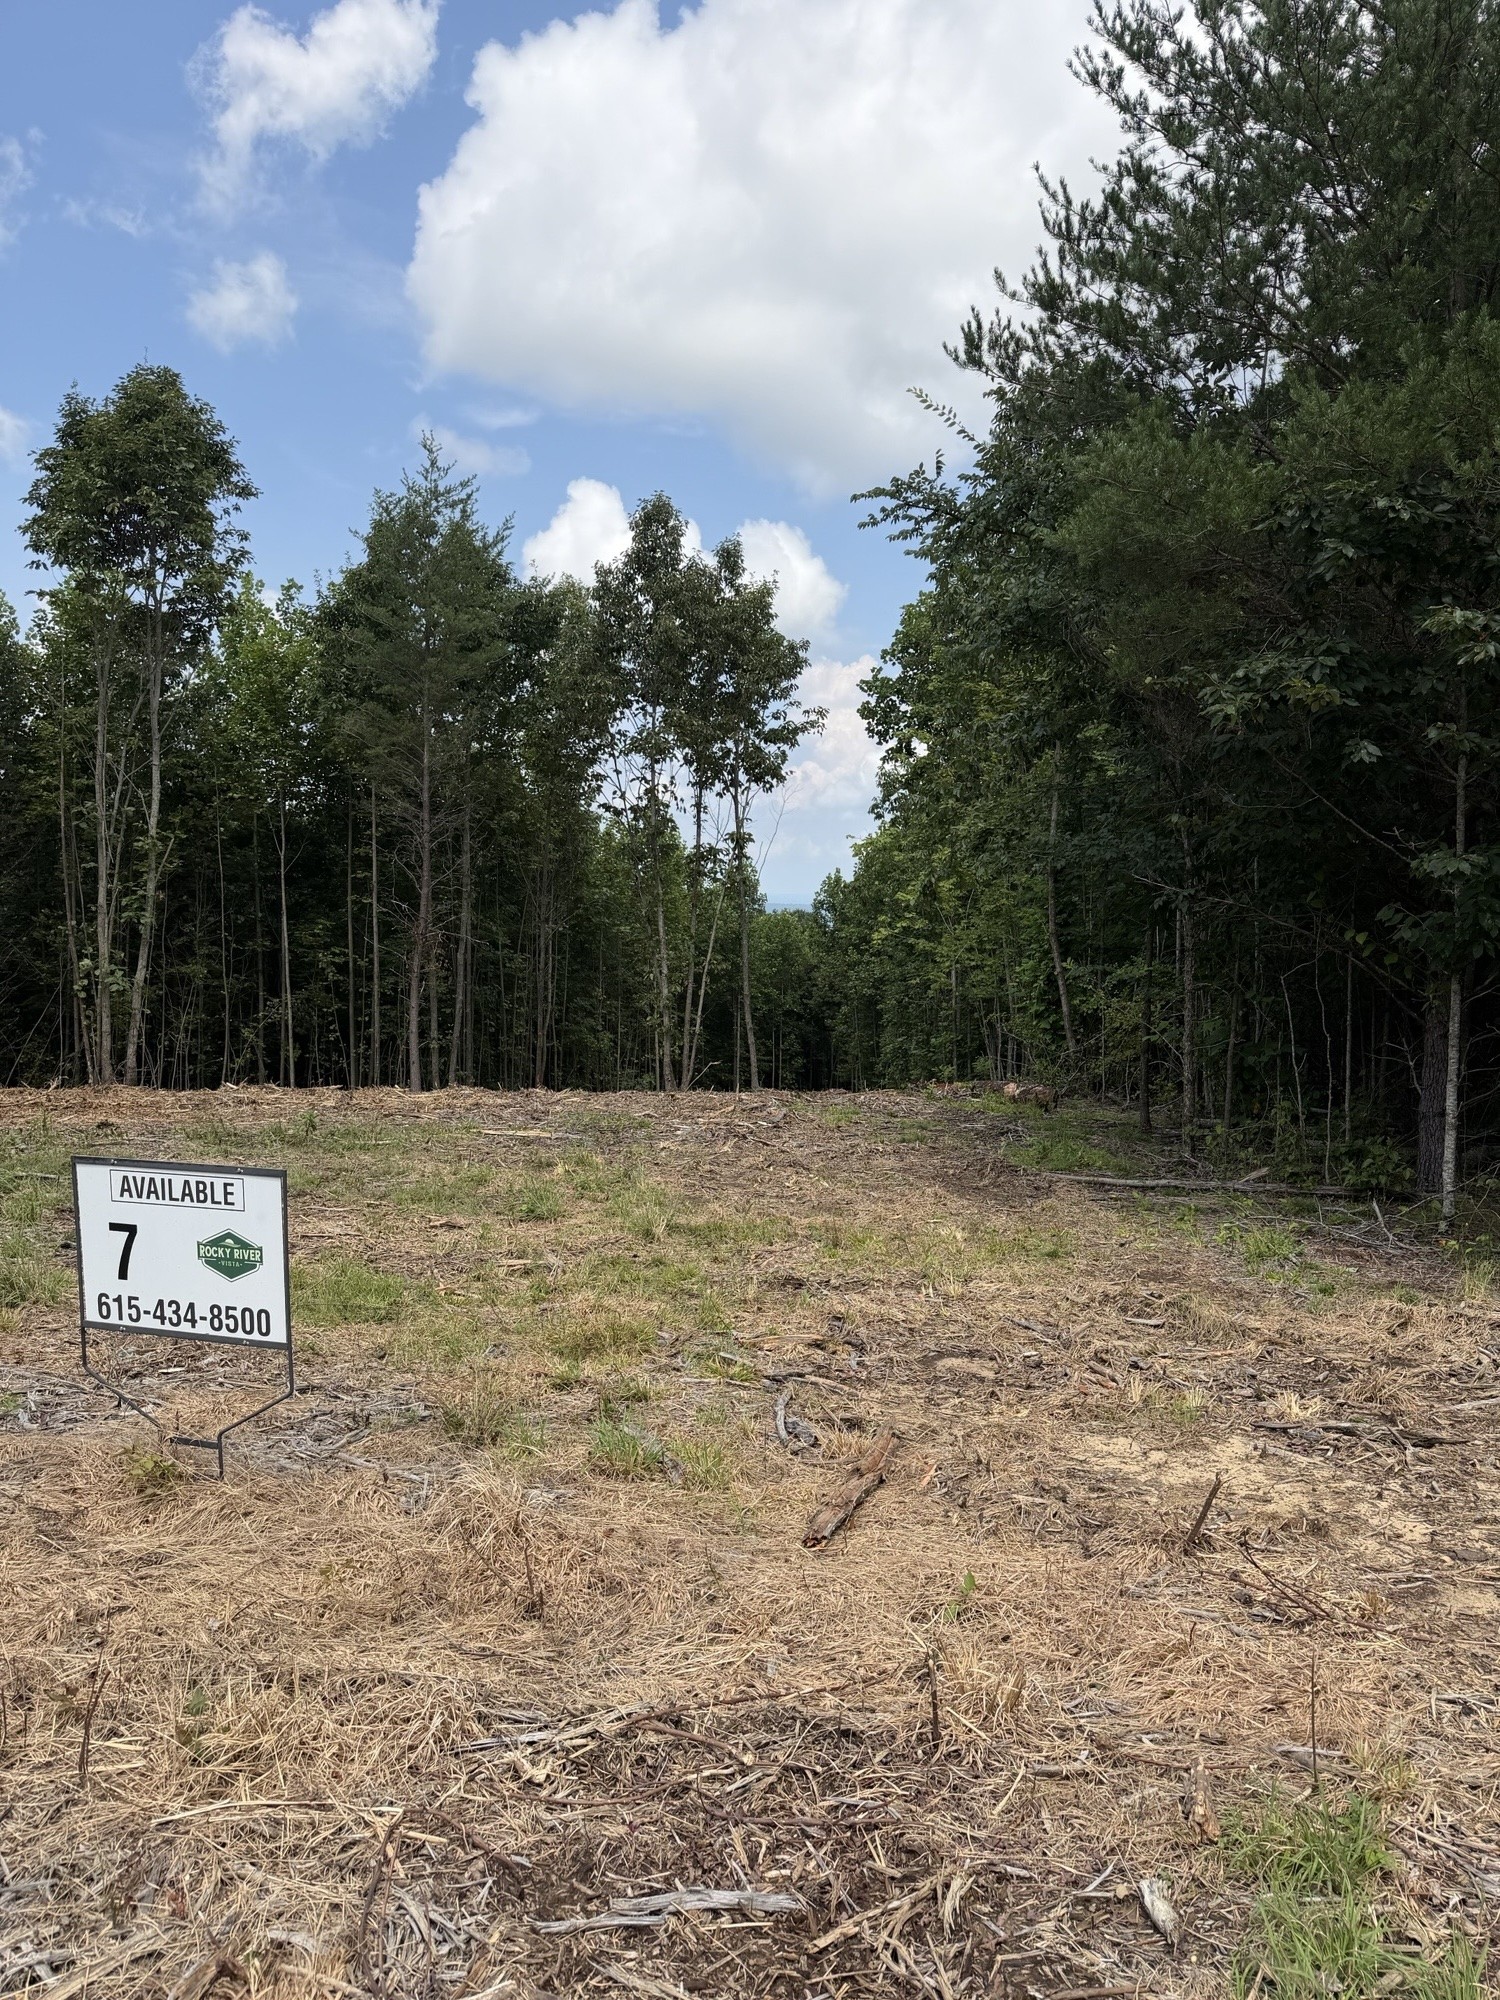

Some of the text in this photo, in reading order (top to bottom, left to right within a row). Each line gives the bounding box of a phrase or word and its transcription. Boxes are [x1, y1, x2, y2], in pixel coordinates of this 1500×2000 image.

[119, 1175, 235, 1206] AVAILABLE
[108, 1222, 138, 1281] 7
[199, 1245, 261, 1261] ROCKY RIVER
[97, 1292, 271, 1337] 615-434-8500
